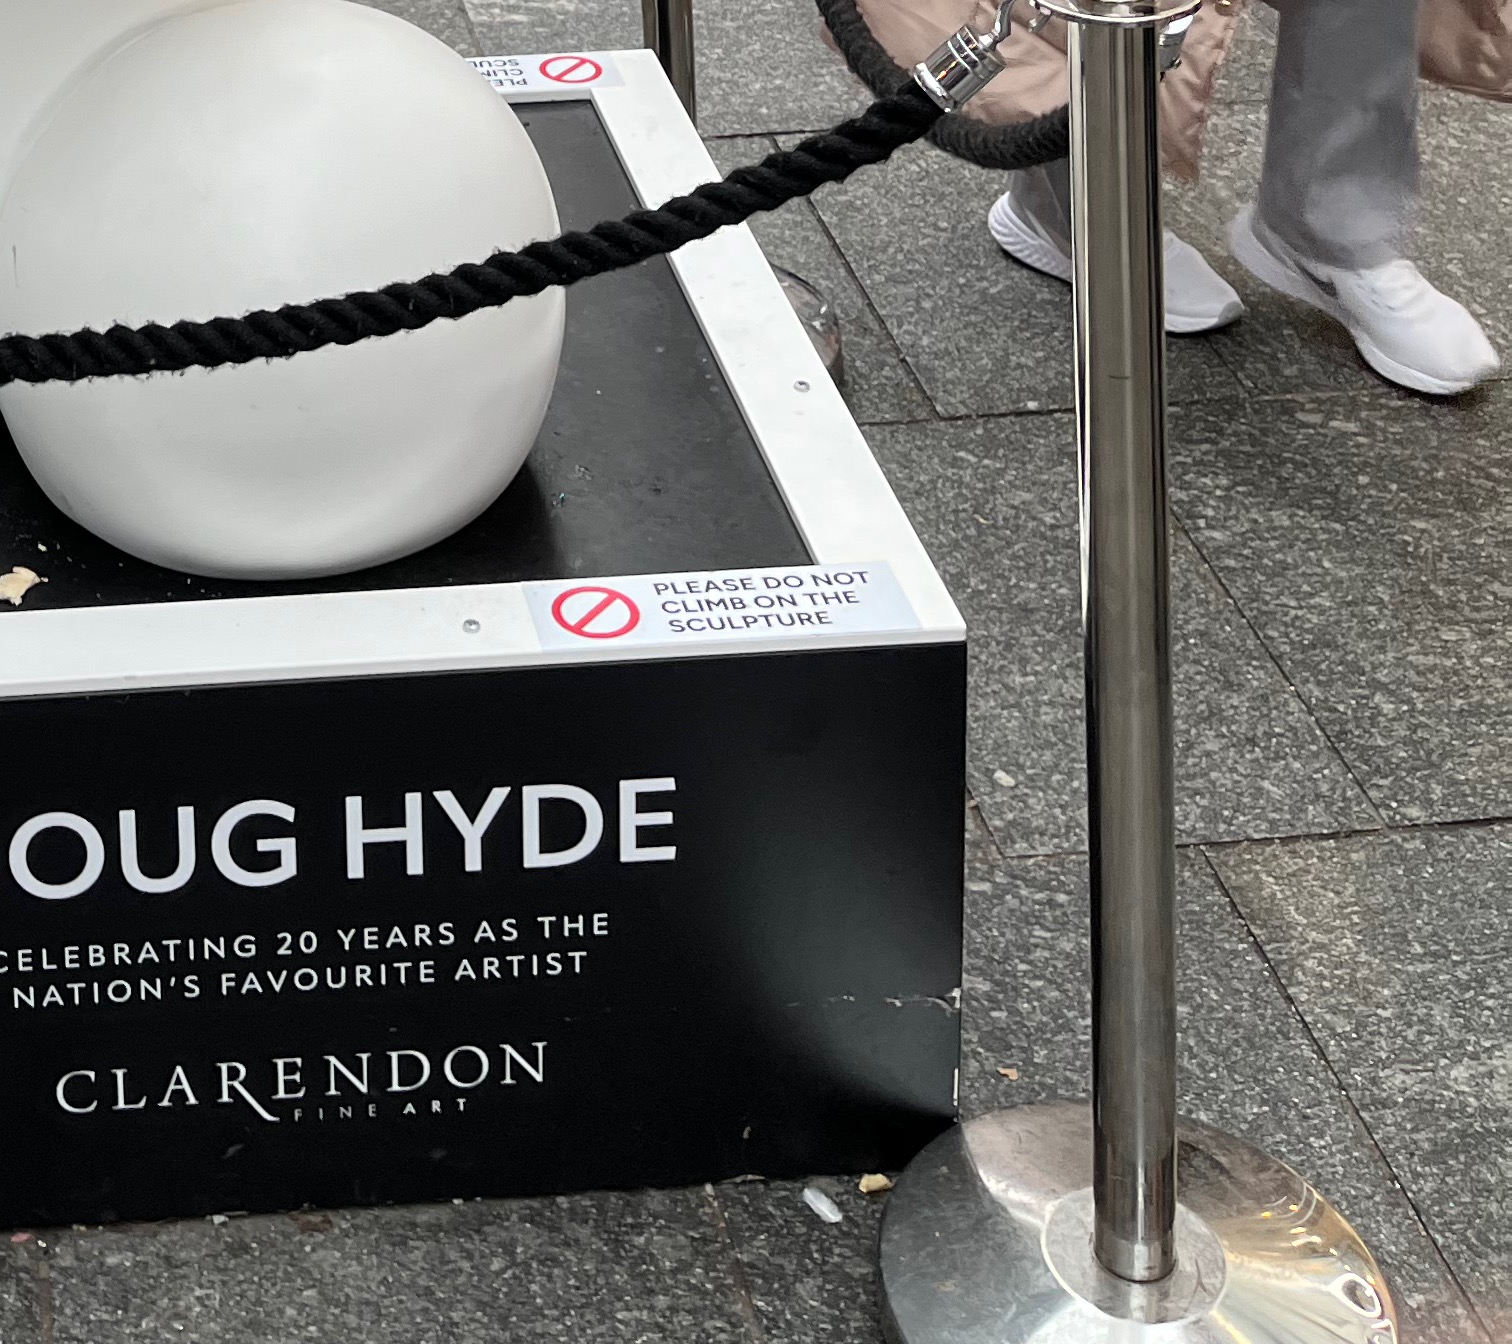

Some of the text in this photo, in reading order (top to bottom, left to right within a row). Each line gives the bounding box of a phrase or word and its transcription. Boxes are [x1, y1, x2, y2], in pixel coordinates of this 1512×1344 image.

[654, 571, 869, 595] PLEASE DO NOT
[662, 591, 859, 614] CLIMB ON THE
[669, 611, 832, 633] SCULPTURE
[345, 777, 677, 879] HYDE
[277, 931, 319, 956] 20
[337, 921, 456, 949] YEARS
[474, 918, 520, 943] AS
[537, 913, 611, 939] THE
[12, 951, 589, 1010] NATION'S FAVOURITE ARTIST
[55, 1042, 548, 1121] CLARENDON
[294, 1097, 467, 1122] FINE ART
